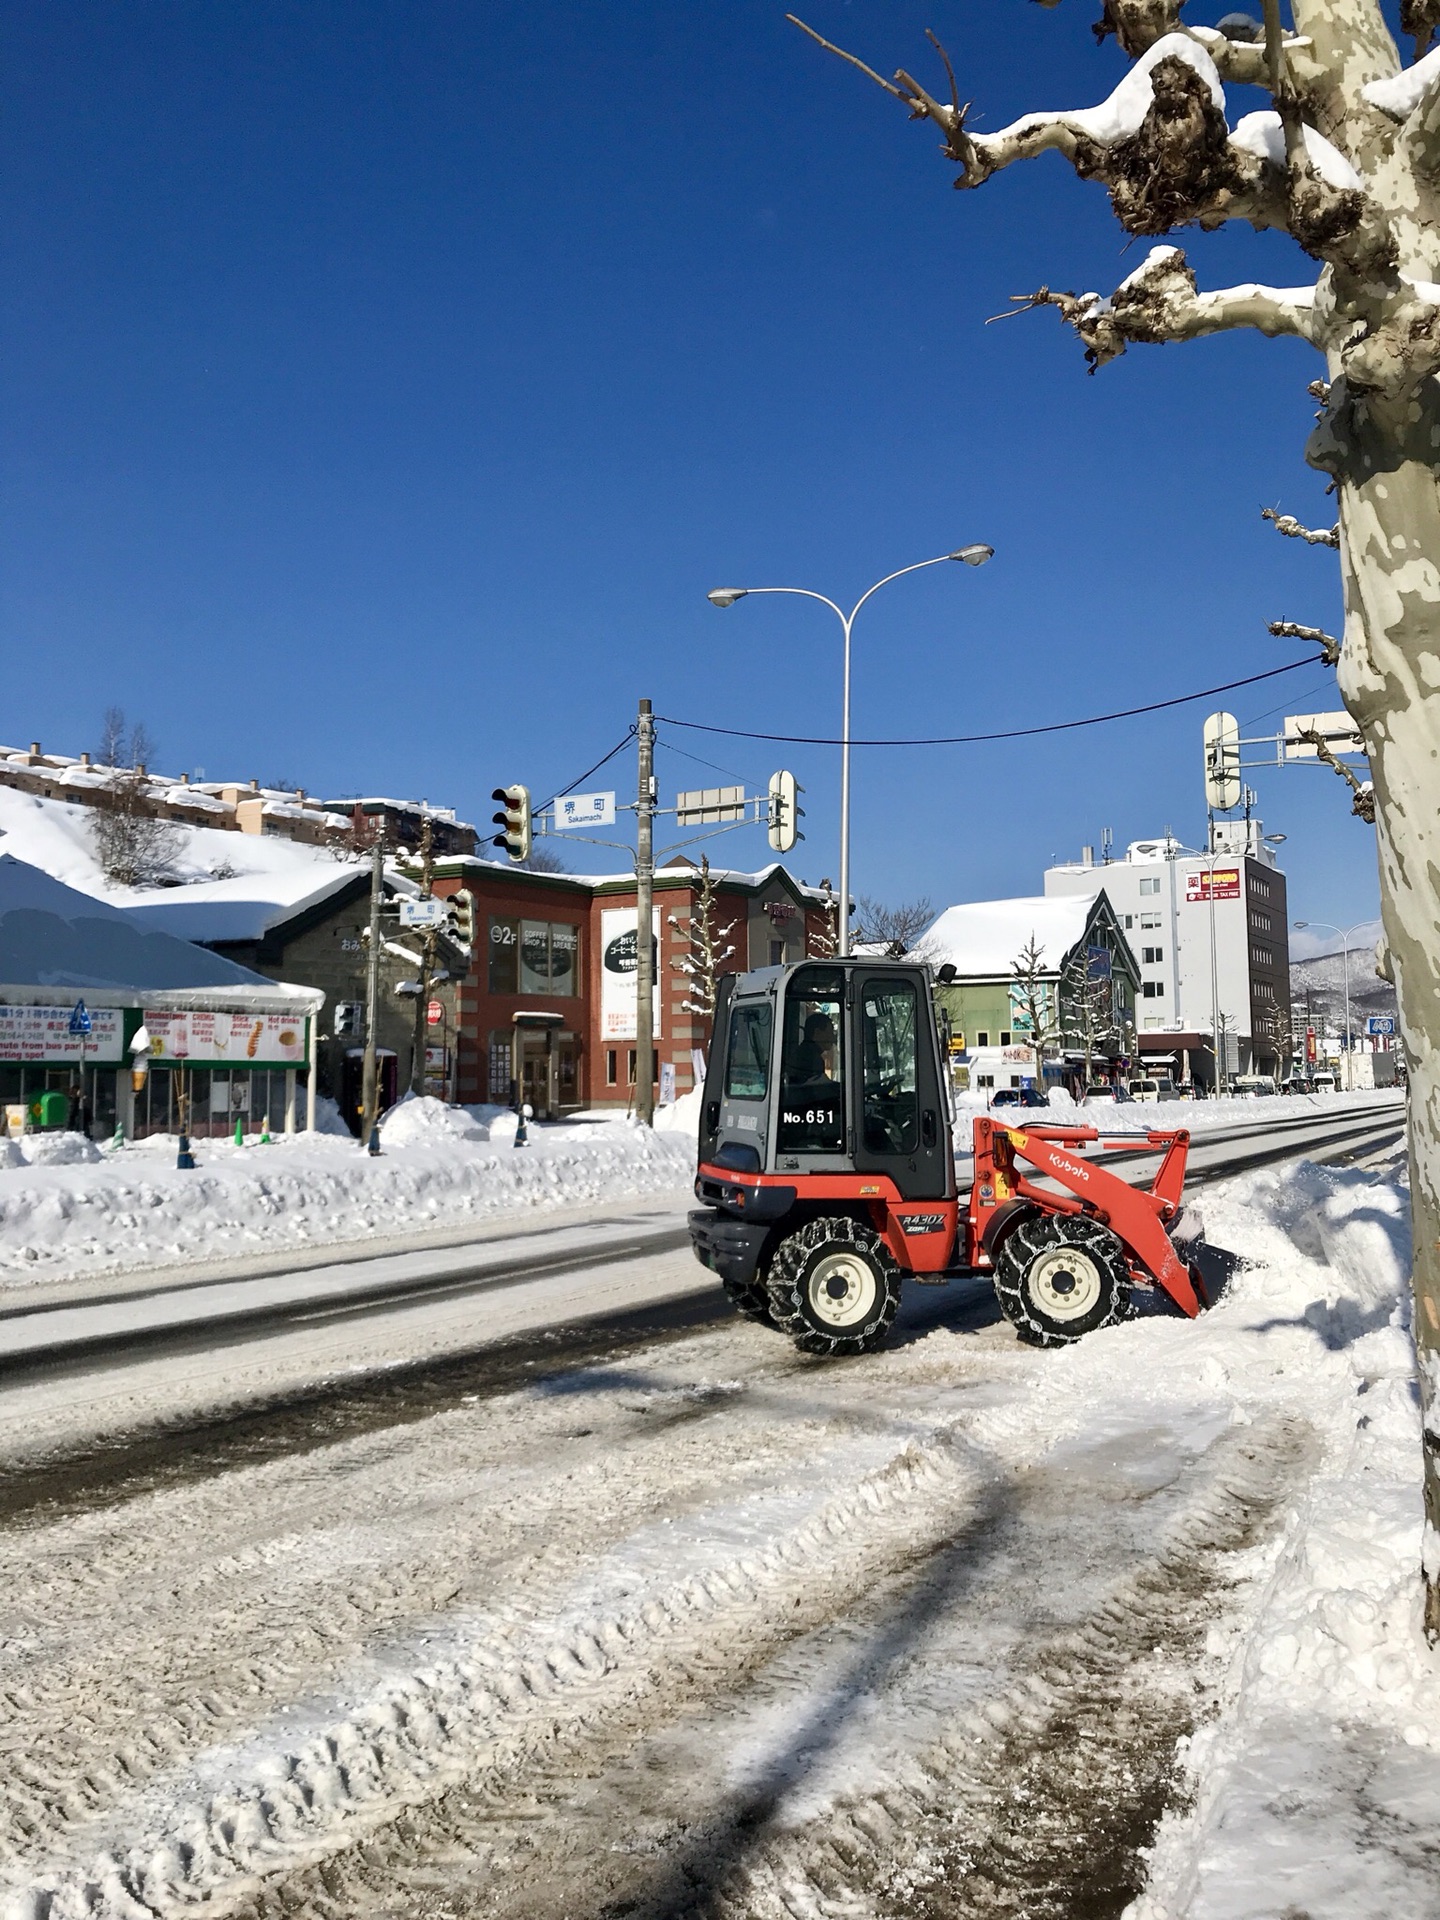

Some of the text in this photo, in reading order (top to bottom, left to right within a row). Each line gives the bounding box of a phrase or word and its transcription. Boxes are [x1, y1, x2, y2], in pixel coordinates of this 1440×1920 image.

[568, 813, 602, 823] Sakaimachi
[524, 930, 547, 939] COFFEE
[552, 933, 578, 942] SMOKING
[524, 938, 540, 946] SHOP
[46, 1042, 62, 1050] bus
[1049, 1153, 1090, 1181] Kubota
